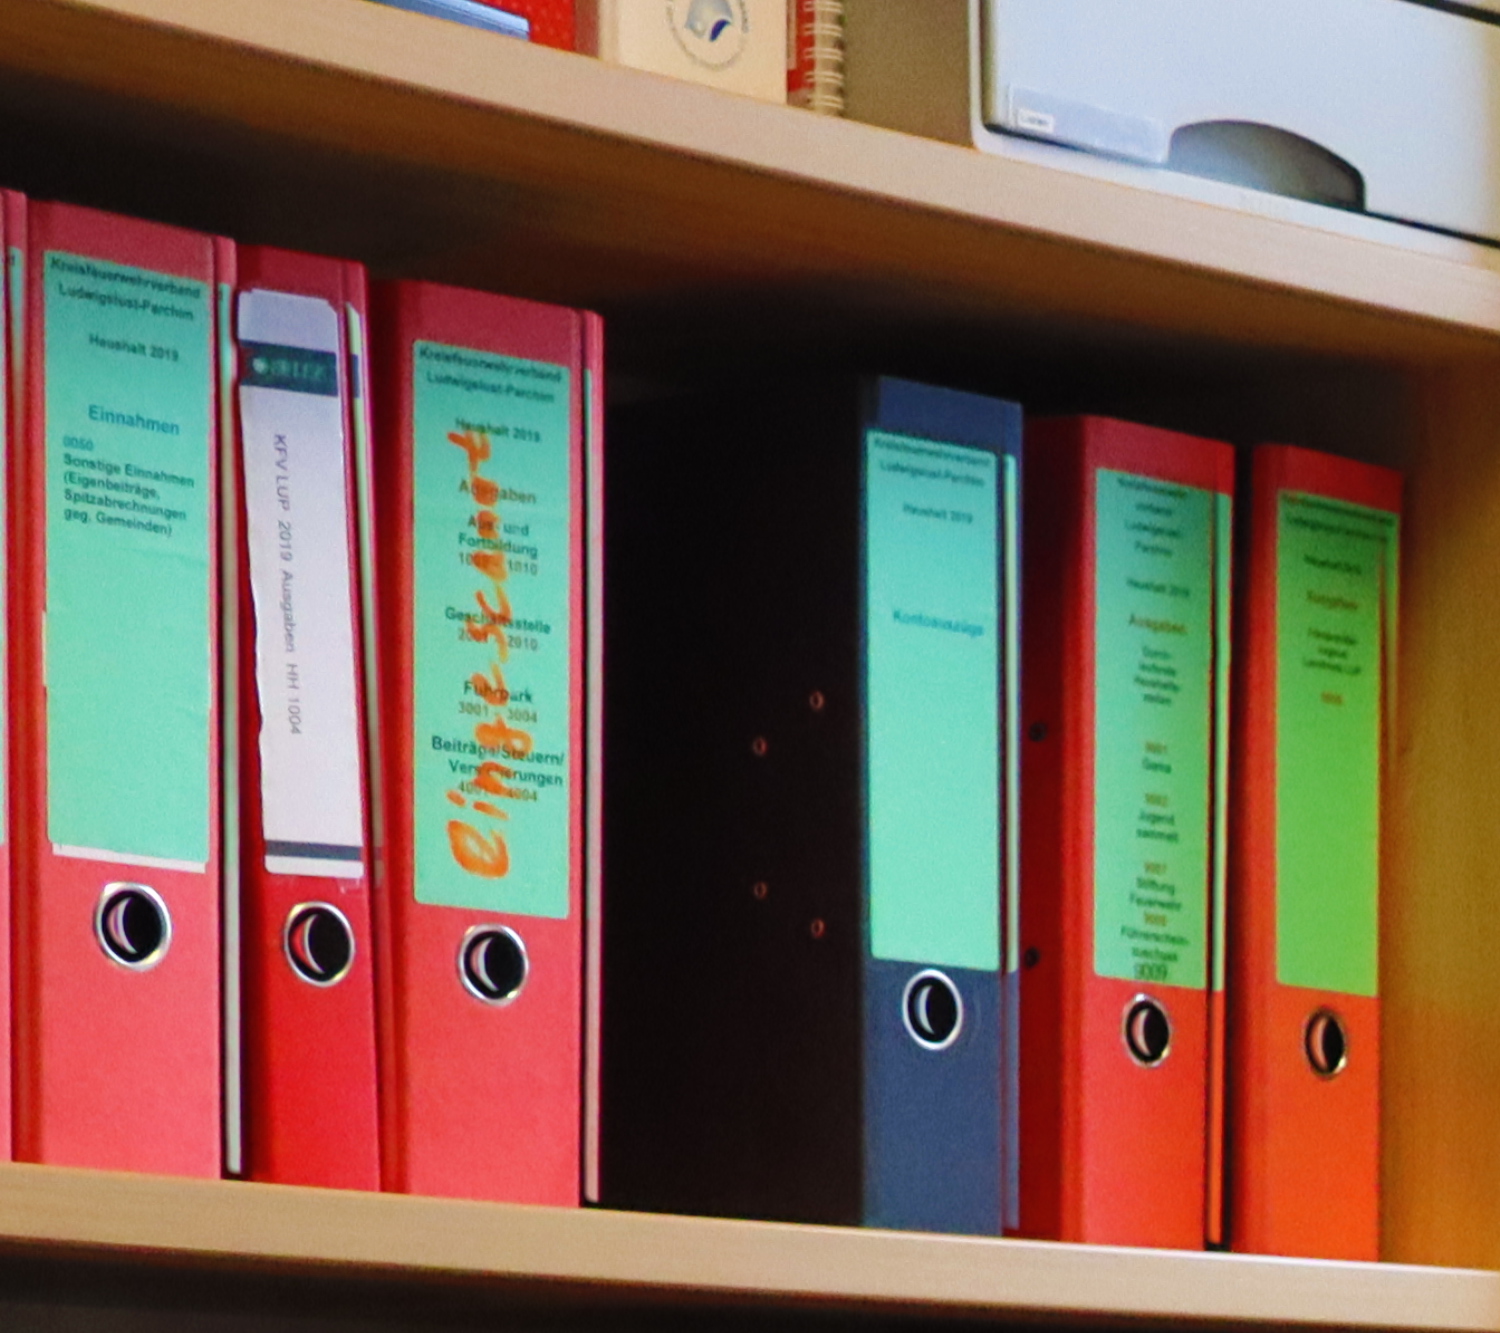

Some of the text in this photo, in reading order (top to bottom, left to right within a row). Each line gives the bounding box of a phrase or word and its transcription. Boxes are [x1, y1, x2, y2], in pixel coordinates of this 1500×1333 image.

[89, 334, 146, 355] Haushalt
[88, 404, 179, 435] Einnahmen
[273, 434, 288, 471] KFV
[64, 453, 194, 487] Sonstige Einnahmen
[64, 471, 160, 499] (Eigenbeiträge,
[64, 489, 186, 520] Spitzabrechnungen
[64, 508, 172, 536] geg. Gemeinden)
[278, 520, 292, 561] 2019
[280, 570, 297, 652] Ausgaben
[287, 663, 298, 689] HH
[287, 697, 302, 735] 1004
